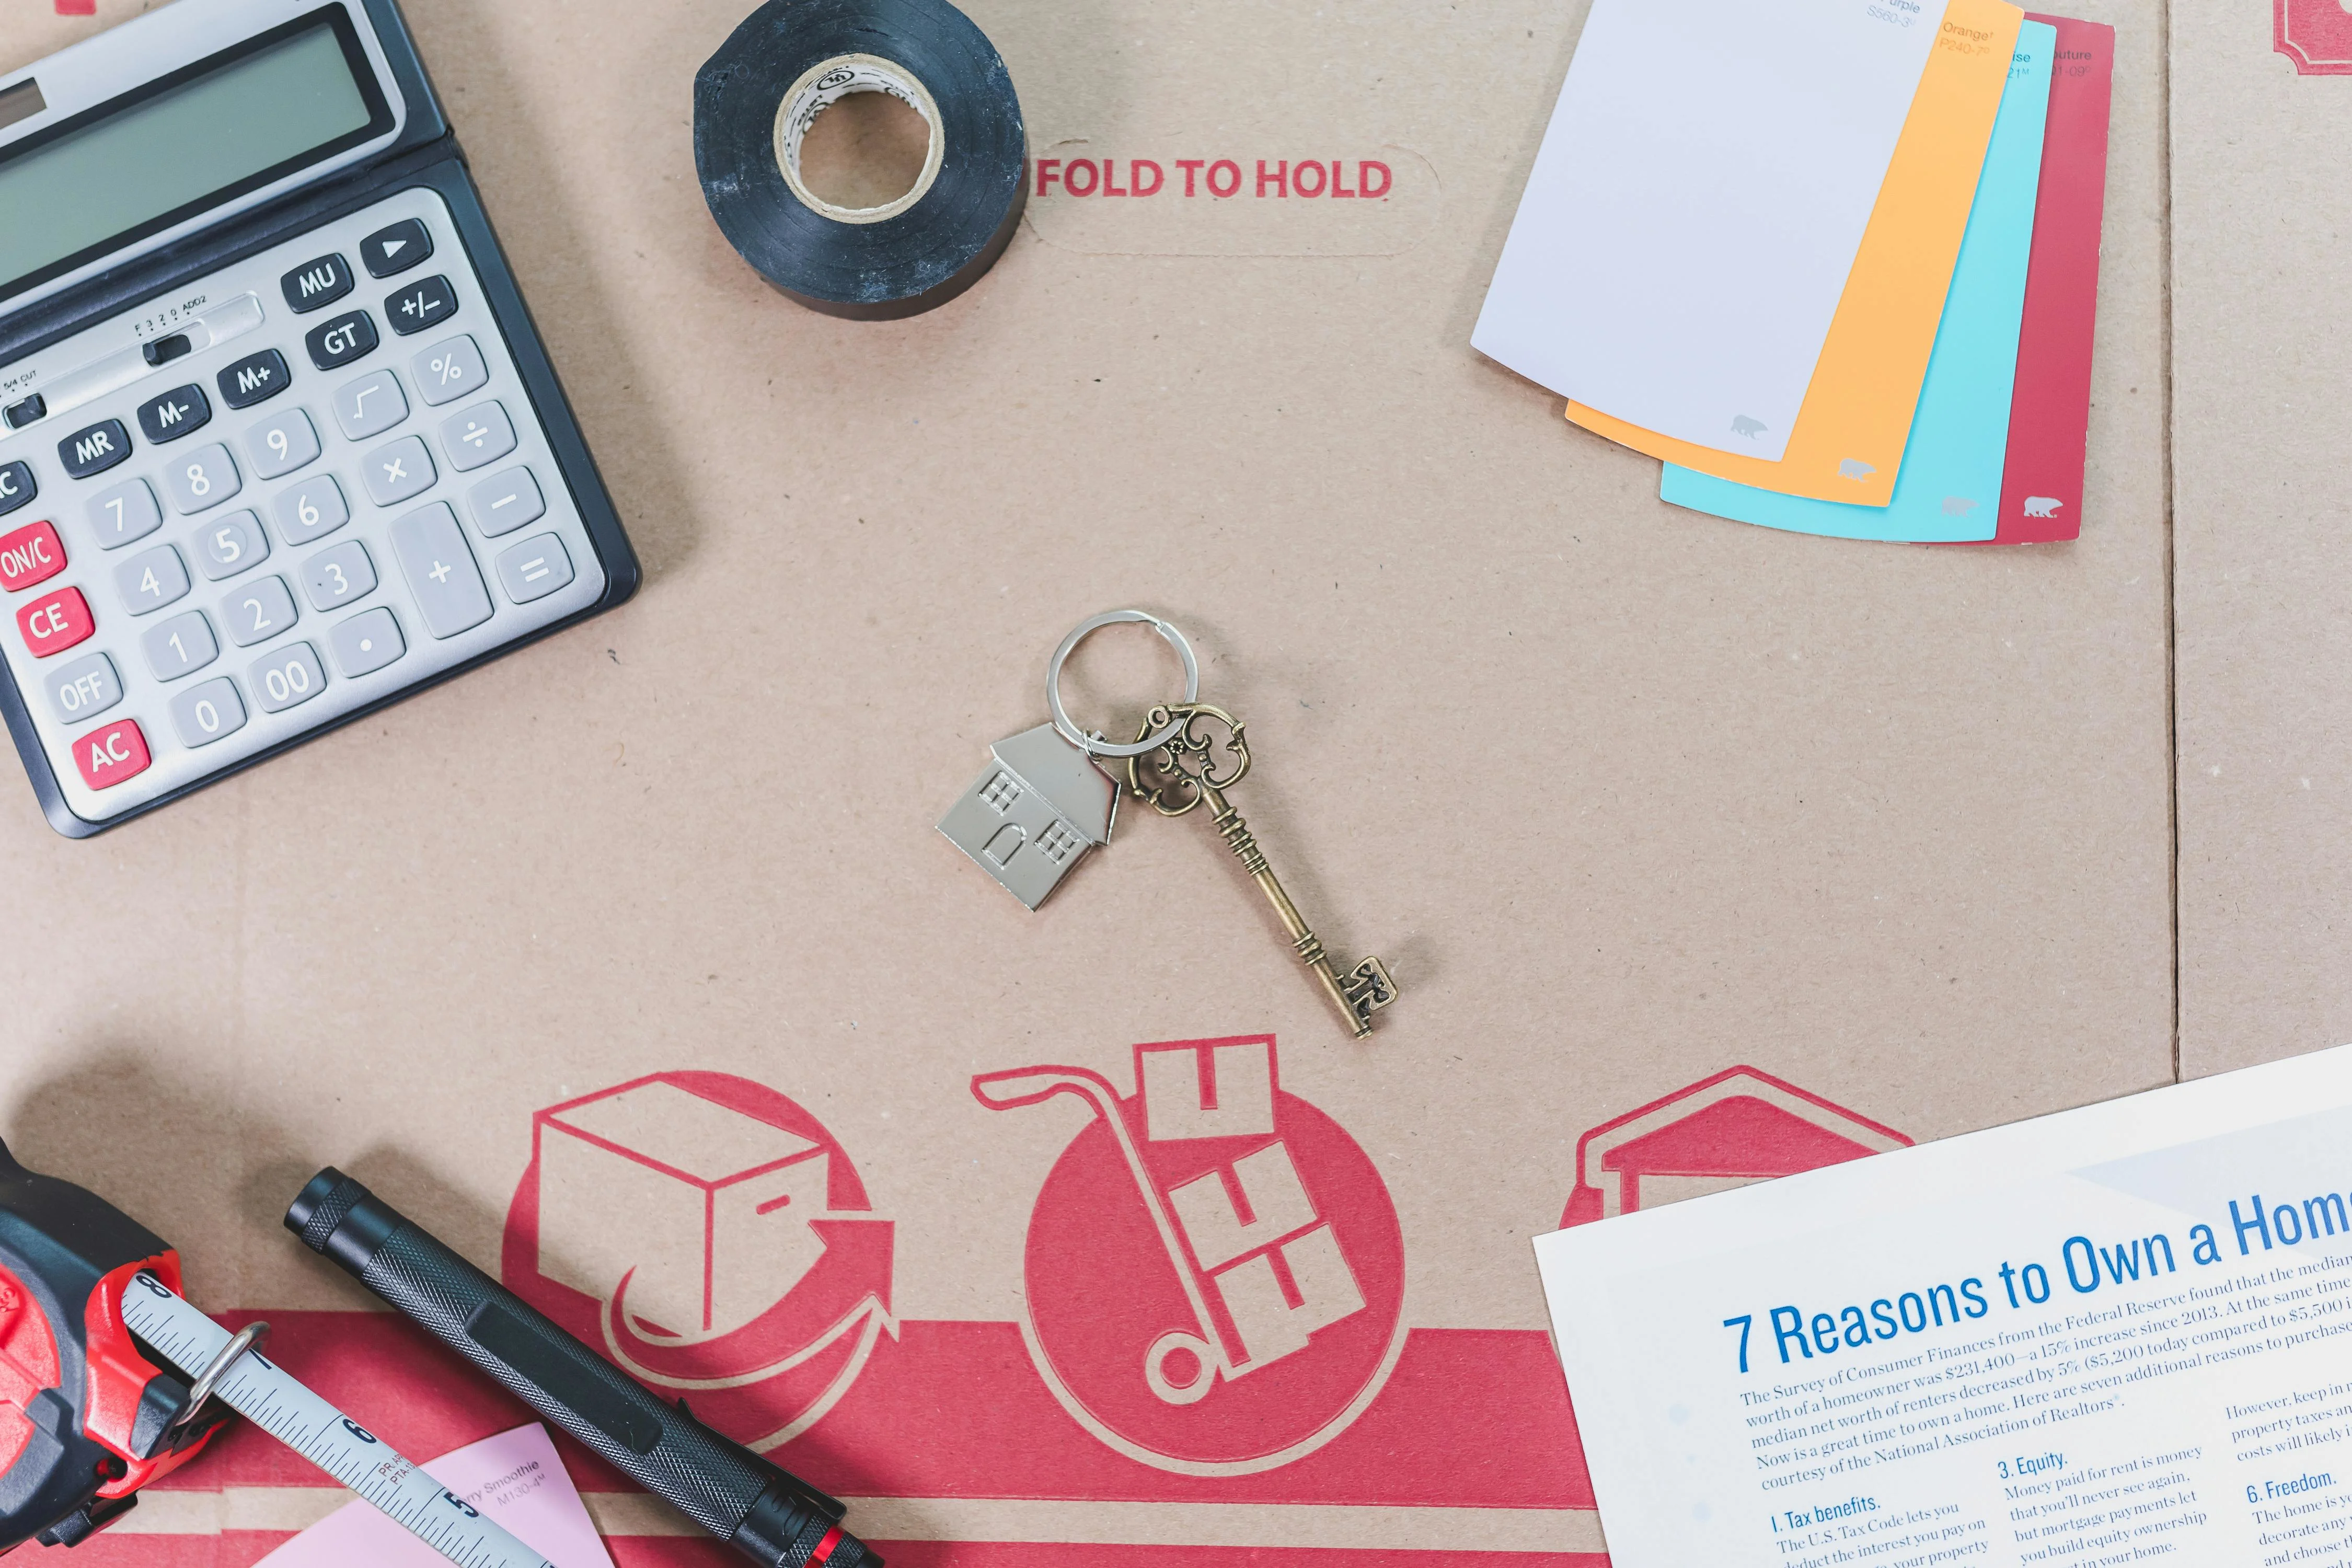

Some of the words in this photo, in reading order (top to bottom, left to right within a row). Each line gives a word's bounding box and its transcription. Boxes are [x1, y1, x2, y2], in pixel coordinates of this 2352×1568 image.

[1036, 158, 1165, 198] FOLD
[1175, 159, 1242, 198] TO
[1255, 160, 1393, 199] HOLD
[299, 262, 336, 298] MU
[324, 322, 356, 355] GT
[20, 370, 37, 382] CUT
[237, 366, 271, 394] M+
[430, 353, 462, 385] %
[158, 403, 190, 429] M-
[76, 431, 114, 465] MR
[267, 429, 288, 460] 9
[0, 471, 18, 499] C
[187, 464, 210, 496] 8
[105, 497, 123, 532] 7
[298, 494, 319, 526] 6
[1, 536, 51, 578] ON/C
[215, 528, 240, 563] 5
[140, 567, 160, 597] 4
[324, 563, 349, 595] 3
[29, 602, 68, 639] CE
[243, 598, 271, 631] 2
[169, 632, 188, 663] 1
[60, 671, 102, 712] OFF
[266, 661, 309, 701] 00
[195, 700, 220, 733] 0
[91, 732, 130, 773] AC
[135, 1274, 172, 1298] 8
[1722, 1314, 1752, 1374] 7
[1769, 1277, 1988, 1364] Reasons
[1998, 1261, 2050, 1309] to
[2062, 1233, 2176, 1294] Own
[2189, 1224, 2222, 1265] a
[2228, 1191, 2352, 1255] Hom
[1740, 1391, 1770, 1406] The
[1773, 1379, 1825, 1399] Survey
[1829, 1370, 1843, 1386] of
[1846, 1355, 1923, 1381] Consumer
[1926, 1338, 1996, 1362] Finances
[1998, 1330, 2035, 1346] from
[2038, 1322, 2062, 1336] the
[2065, 1305, 2123, 1330] Federal
[2126, 1295, 2186, 1316] Reserve
[2189, 1279, 2233, 1301] found
[2236, 1273, 2267, 1290] that
[2270, 1267, 2293, 1283] the
[1745, 1406, 1791, 1427] worth
[1794, 1400, 1808, 1416] of
[1812, 1403, 1820, 1412] a
[1821, 1380, 1910, 1410] homeowner
[1913, 1373, 1942, 1388] was
[2041, 1340, 2071, 1358] 15%
[2074, 1328, 2137, 1351] increase
[2140, 1318, 2178, 1335] since
[2182, 1306, 2222, 1325] 2013.
[2226, 1300, 2243, 1316] At
[2246, 1296, 2270, 1310] the
[2274, 1287, 2312, 1304] same
[2316, 1278, 2350, 1294] time
[1751, 1427, 1807, 1448] median
[1811, 1419, 1835, 1434] net
[1837, 1406, 1882, 1427] worth
[1886, 1400, 1900, 1416] of
[1903, 1391, 1956, 1413] renters
[1959, 1369, 2034, 1399] decreased
[2035, 1368, 2054, 1382] by
[2058, 1359, 2080, 1376] 5%
[2084, 1345, 2143, 1370] ($5,200
[2147, 1338, 2188, 1355] today
[2192, 1315, 2267, 1345] compared
[2270, 1315, 2286, 1327] to
[2289, 1299, 2342, 1322] $5,500
[1756, 1453, 1790, 1469] Now
[1793, 1448, 1807, 1460] is
[1809, 1447, 1818, 1457] a
[1821, 1435, 1860, 1458] great
[1863, 1428, 1896, 1445] time
[1899, 1423, 1915, 1435] to
[1918, 1416, 1950, 1431] own
[1953, 1413, 1962, 1423] a
[1963, 1402, 2010, 1420] home.
[2013, 1392, 2049, 1409] Here
[2053, 1386, 2077, 1399] are
[2080, 1376, 2122, 1393] seven
[2125, 1353, 2202, 1382] additional
[2205, 1342, 2263, 1364] reasons
[2266, 1338, 2281, 1350] to
[2284, 1322, 2352, 1348] purchase
[341, 1418, 377, 1444] 6
[1762, 1467, 1826, 1490] courtesy
[1830, 1458, 1844, 1474] of
[1848, 1455, 1871, 1470] the
[1873, 1436, 1939, 1463] National
[1943, 1420, 2029, 1448] Association
[2032, 1410, 2047, 1426] of
[1998, 1461, 2014, 1479] 3.
[2016, 1452, 2068, 1476] Equity.
[463, 1489, 482, 1504] rry
[483, 1461, 539, 1494] Smoothie
[2004, 1481, 2051, 1501] Money
[2055, 1470, 2085, 1491] paid
[2088, 1468, 2107, 1481] for
[2111, 1460, 2139, 1475] rent
[2141, 1456, 2153, 1468] is
[2156, 1447, 2201, 1465] money
[2246, 1485, 2263, 1503] 6.
[2265, 1473, 2336, 1499] Freedom.
[443, 1491, 479, 1518] 5
[1784, 1511, 1812, 1529] Tax
[1814, 1496, 1881, 1522] benefits.
[2010, 1505, 2038, 1521] that
[2082, 1488, 2119, 1505] never
[2123, 1483, 2144, 1495] see
[2147, 1471, 2190, 1490] again,
[1776, 1539, 1805, 1553] The
[1807, 1530, 1837, 1546] U.S.
[1838, 1526, 1866, 1539] Tax
[1867, 1515, 1904, 1532] Code
[1906, 1510, 1931, 1524] lets
[1933, 1504, 1959, 1520] you
[2014, 1528, 2038, 1542] but
[2042, 1514, 2105, 1536] mortgage
[2109, 1497, 2176, 1524] payments
[2178, 1491, 2197, 1504] let
[2020, 1550, 2046, 1566] you
[2047, 1537, 2084, 1556] build
[2087, 1530, 2130, 1548] equity
[2134, 1511, 2207, 1536] ownership
